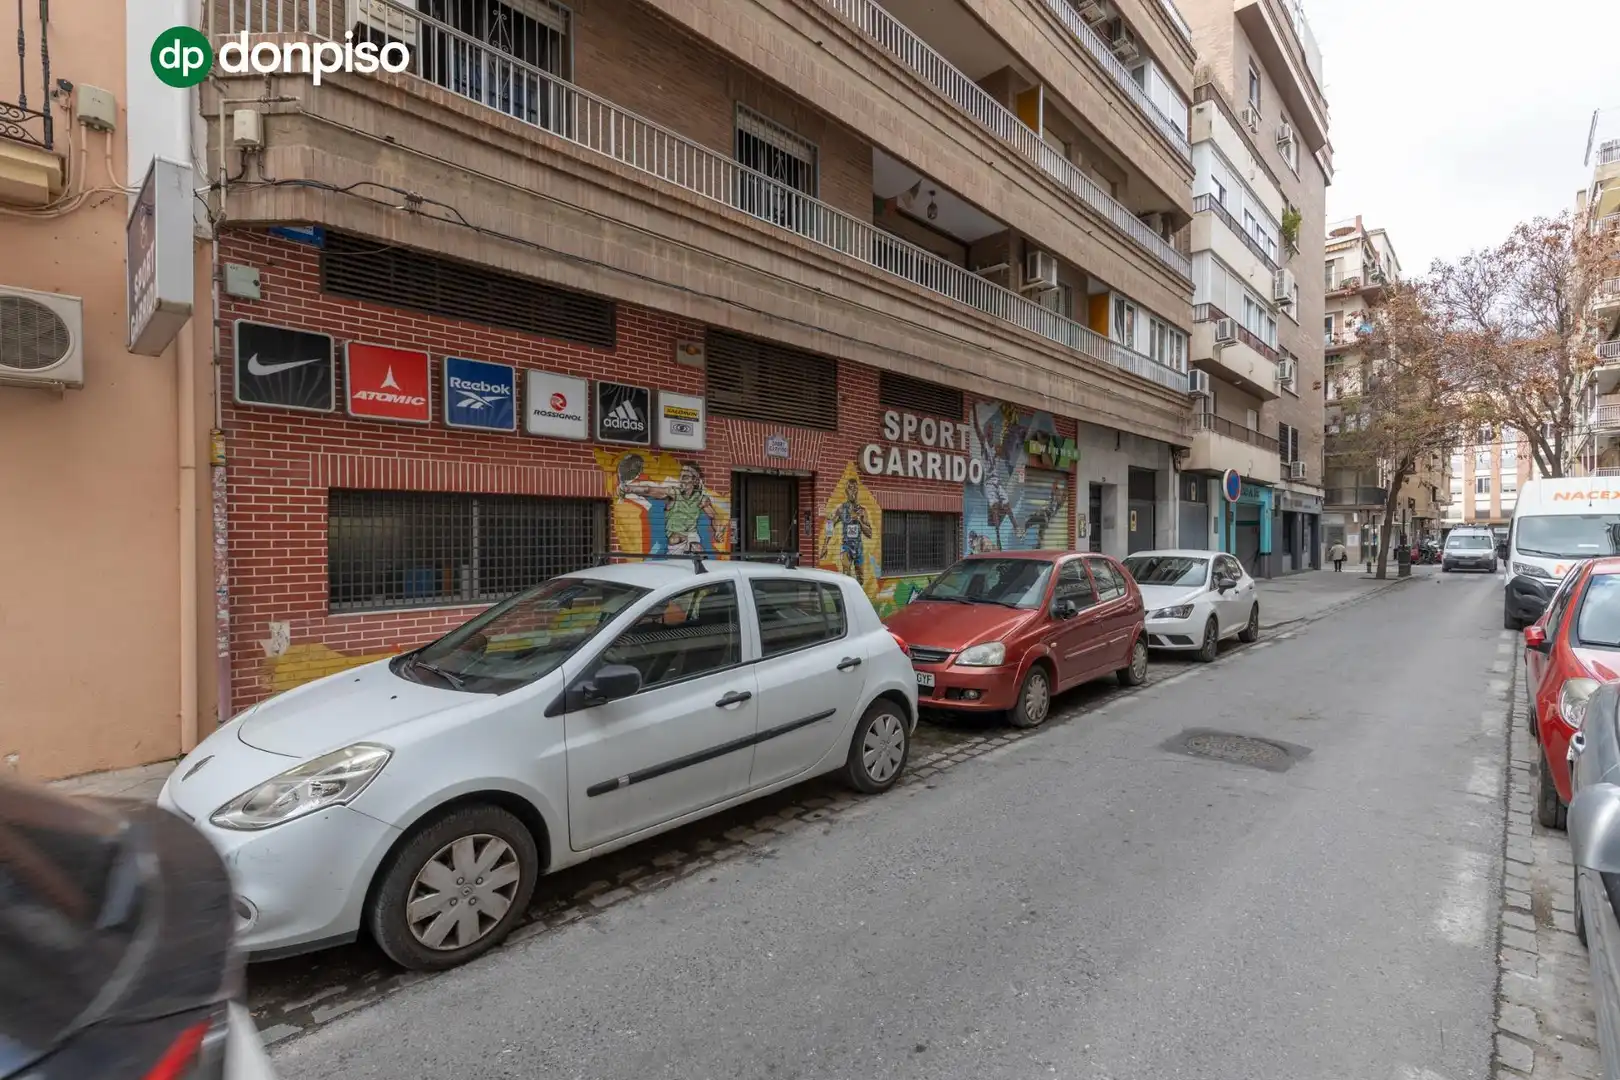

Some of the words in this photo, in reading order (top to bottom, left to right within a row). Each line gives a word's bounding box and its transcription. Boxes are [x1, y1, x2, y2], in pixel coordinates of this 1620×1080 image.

[449, 376, 511, 396] Reebok
[352, 390, 426, 406] ATOMIC
[533, 409, 583, 422] ROSSIGNOL
[603, 417, 645, 432] adidas
[883, 409, 971, 451] SPORT
[862, 443, 983, 484] GARRIDO
[916, 673, 932, 684] GYF
